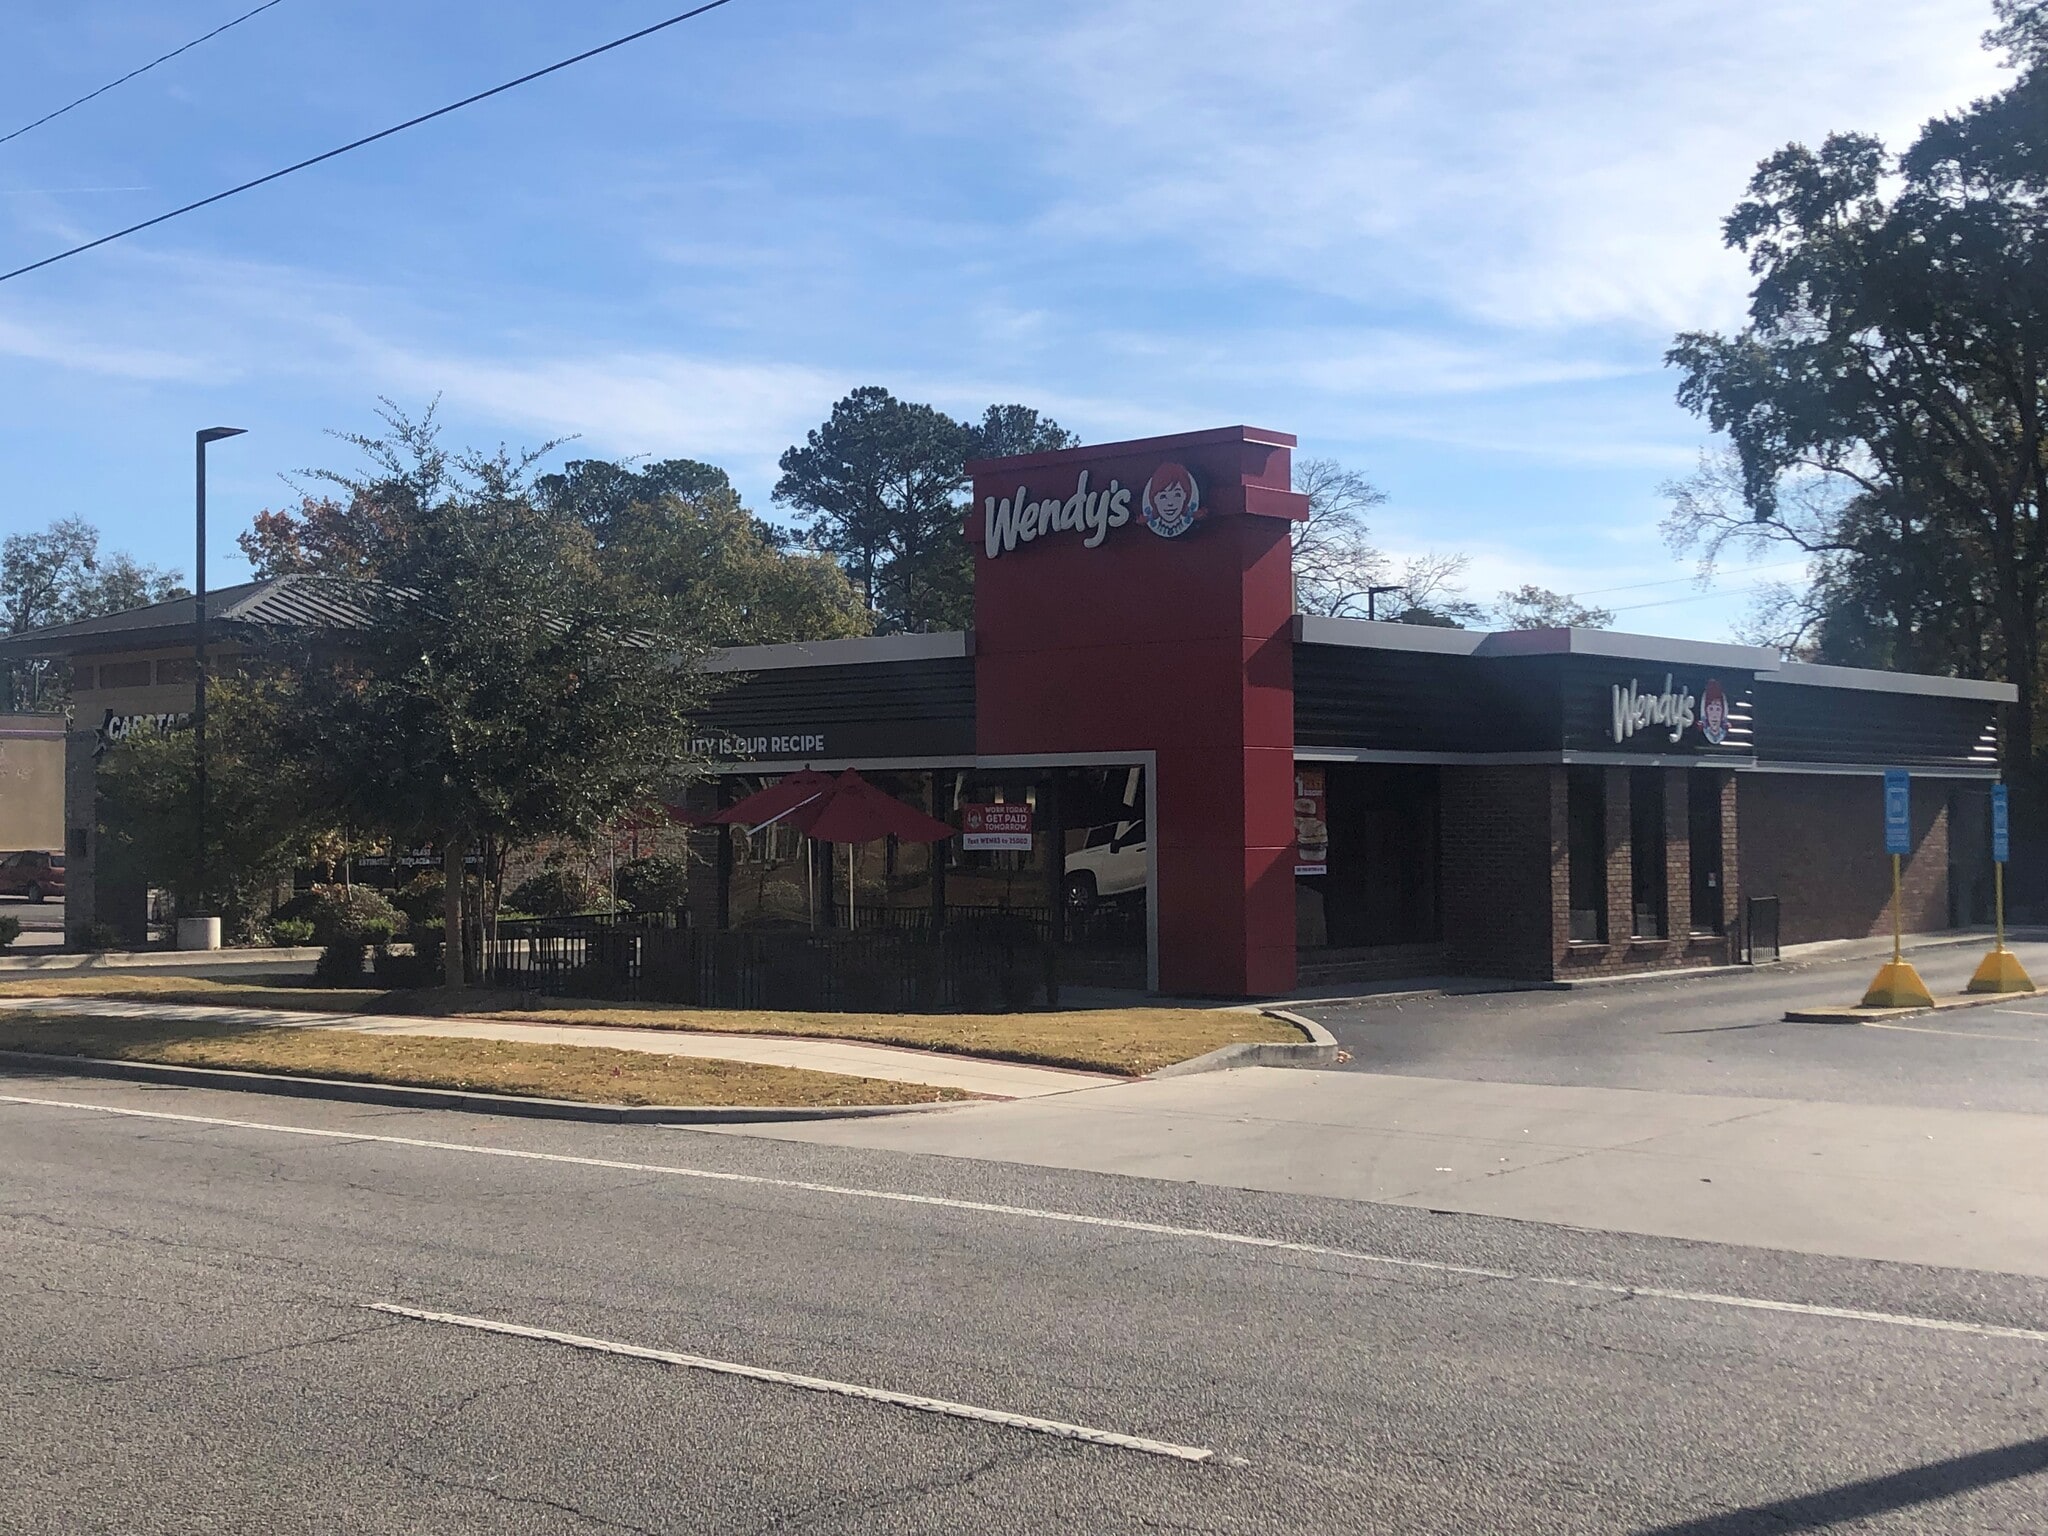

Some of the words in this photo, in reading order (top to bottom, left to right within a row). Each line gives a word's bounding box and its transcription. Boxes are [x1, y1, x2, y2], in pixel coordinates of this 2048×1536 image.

[985, 470, 1131, 559] Wendy's
[1612, 673, 1695, 743] Wendy's
[719, 738, 732, 754] IS
[736, 736, 767, 753] OUR
[771, 735, 825, 752] RECIPE
[986, 814, 1003, 823] GET
[1005, 814, 1027, 823] PAID
